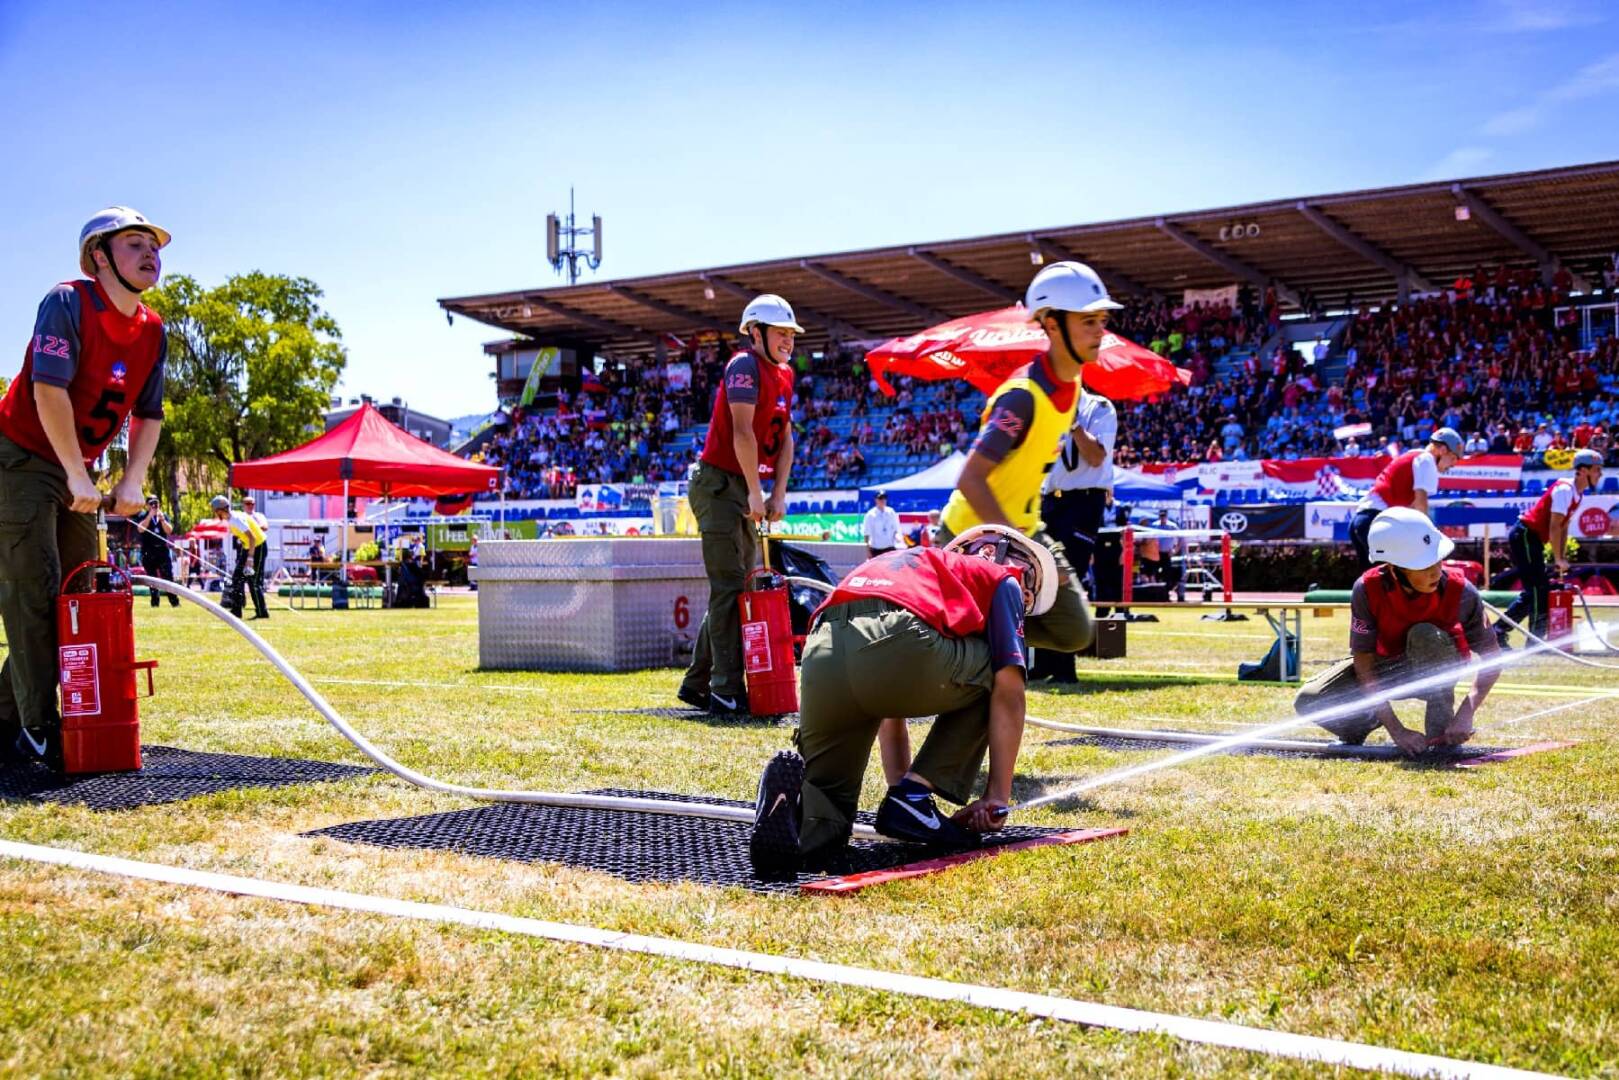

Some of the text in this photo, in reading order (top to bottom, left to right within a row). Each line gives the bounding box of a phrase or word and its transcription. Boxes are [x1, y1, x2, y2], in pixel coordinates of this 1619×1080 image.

[33, 334, 71, 360] 122
[727, 373, 755, 389] 122
[81, 388, 126, 446] 5
[763, 416, 784, 456] 3
[446, 530, 470, 543] FEEL
[674, 595, 689, 630] 6
